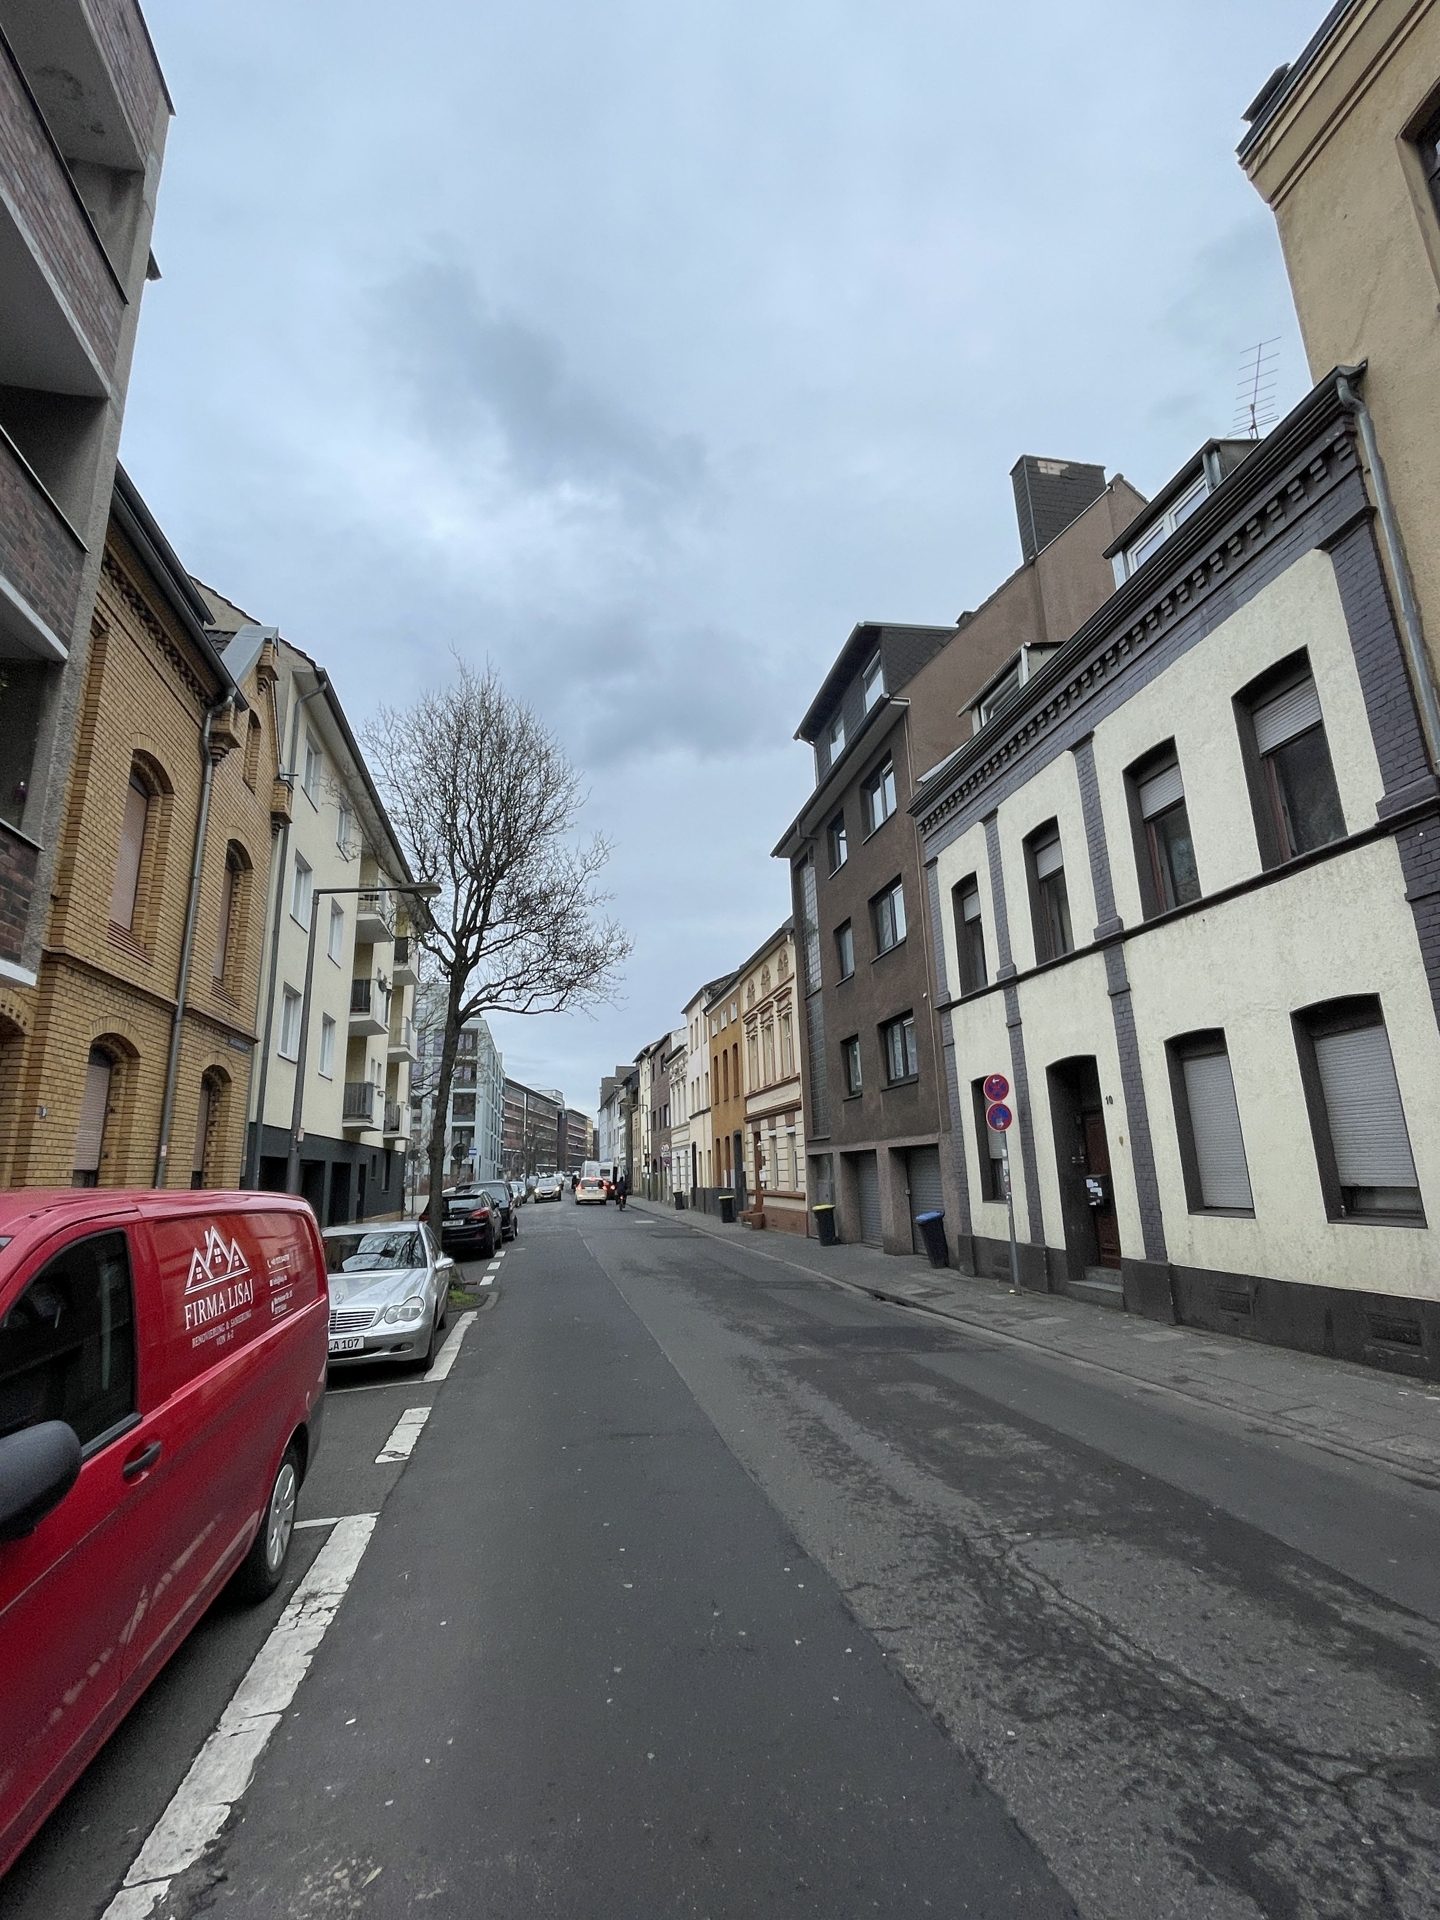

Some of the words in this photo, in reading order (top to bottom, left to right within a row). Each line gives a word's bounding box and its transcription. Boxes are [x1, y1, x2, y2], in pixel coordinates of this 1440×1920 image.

[1105, 1095, 1114, 1105] 10
[184, 1291, 226, 1331] FIRMA
[228, 1278, 254, 1310] LISAJ
[342, 1339, 360, 1350] 107
